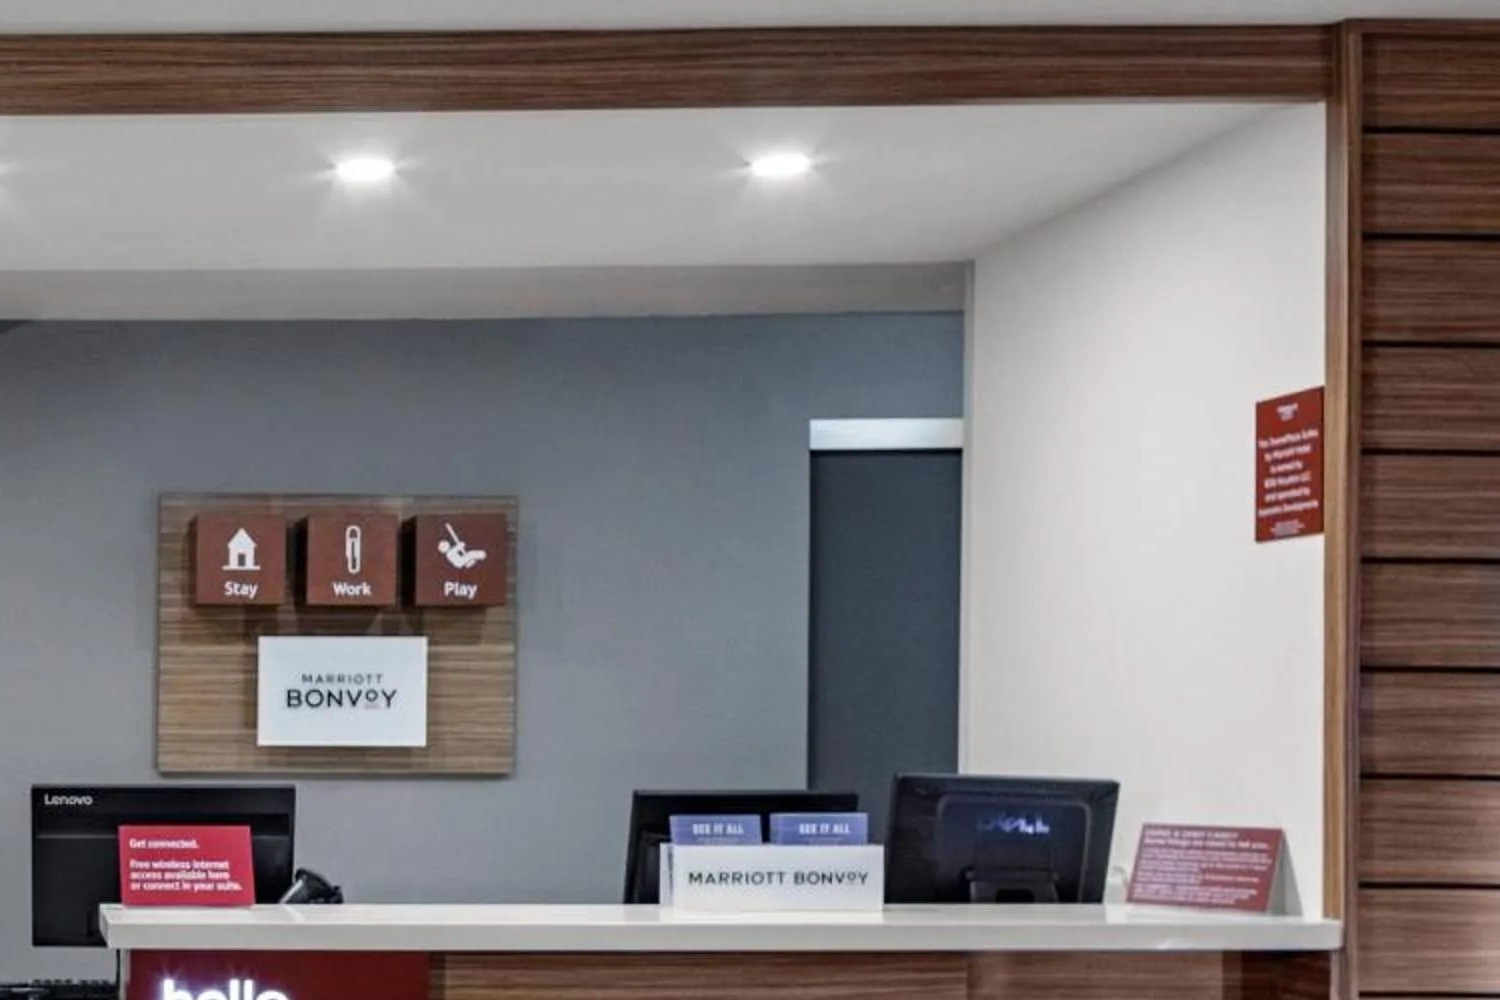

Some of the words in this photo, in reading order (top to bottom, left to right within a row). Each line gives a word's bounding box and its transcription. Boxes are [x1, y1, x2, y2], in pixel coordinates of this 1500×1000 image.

[224, 580, 258, 598] Stay
[333, 581, 372, 596] Work
[443, 581, 478, 599] Play
[301, 673, 384, 685] MARRIOTT
[43, 793, 93, 806] Lenovo
[692, 823, 711, 835] SEE
[713, 823, 724, 835] IT
[725, 823, 745, 835] ALL
[798, 823, 817, 835] SEE
[819, 823, 830, 835] IT
[831, 823, 851, 835] ALL
[129, 838, 147, 849] Get
[147, 839, 199, 849] connected.
[129, 859, 151, 870] Free
[151, 860, 191, 870] wireless
[130, 871, 163, 880] access
[163, 870, 207, 880] available
[207, 871, 231, 880] here
[688, 871, 786, 885] MARRIOTT
[130, 882, 142, 891] or
[143, 881, 181, 891] connect
[182, 881, 193, 891] in
[193, 882, 216, 893] your
[216, 881, 243, 891] suite.
